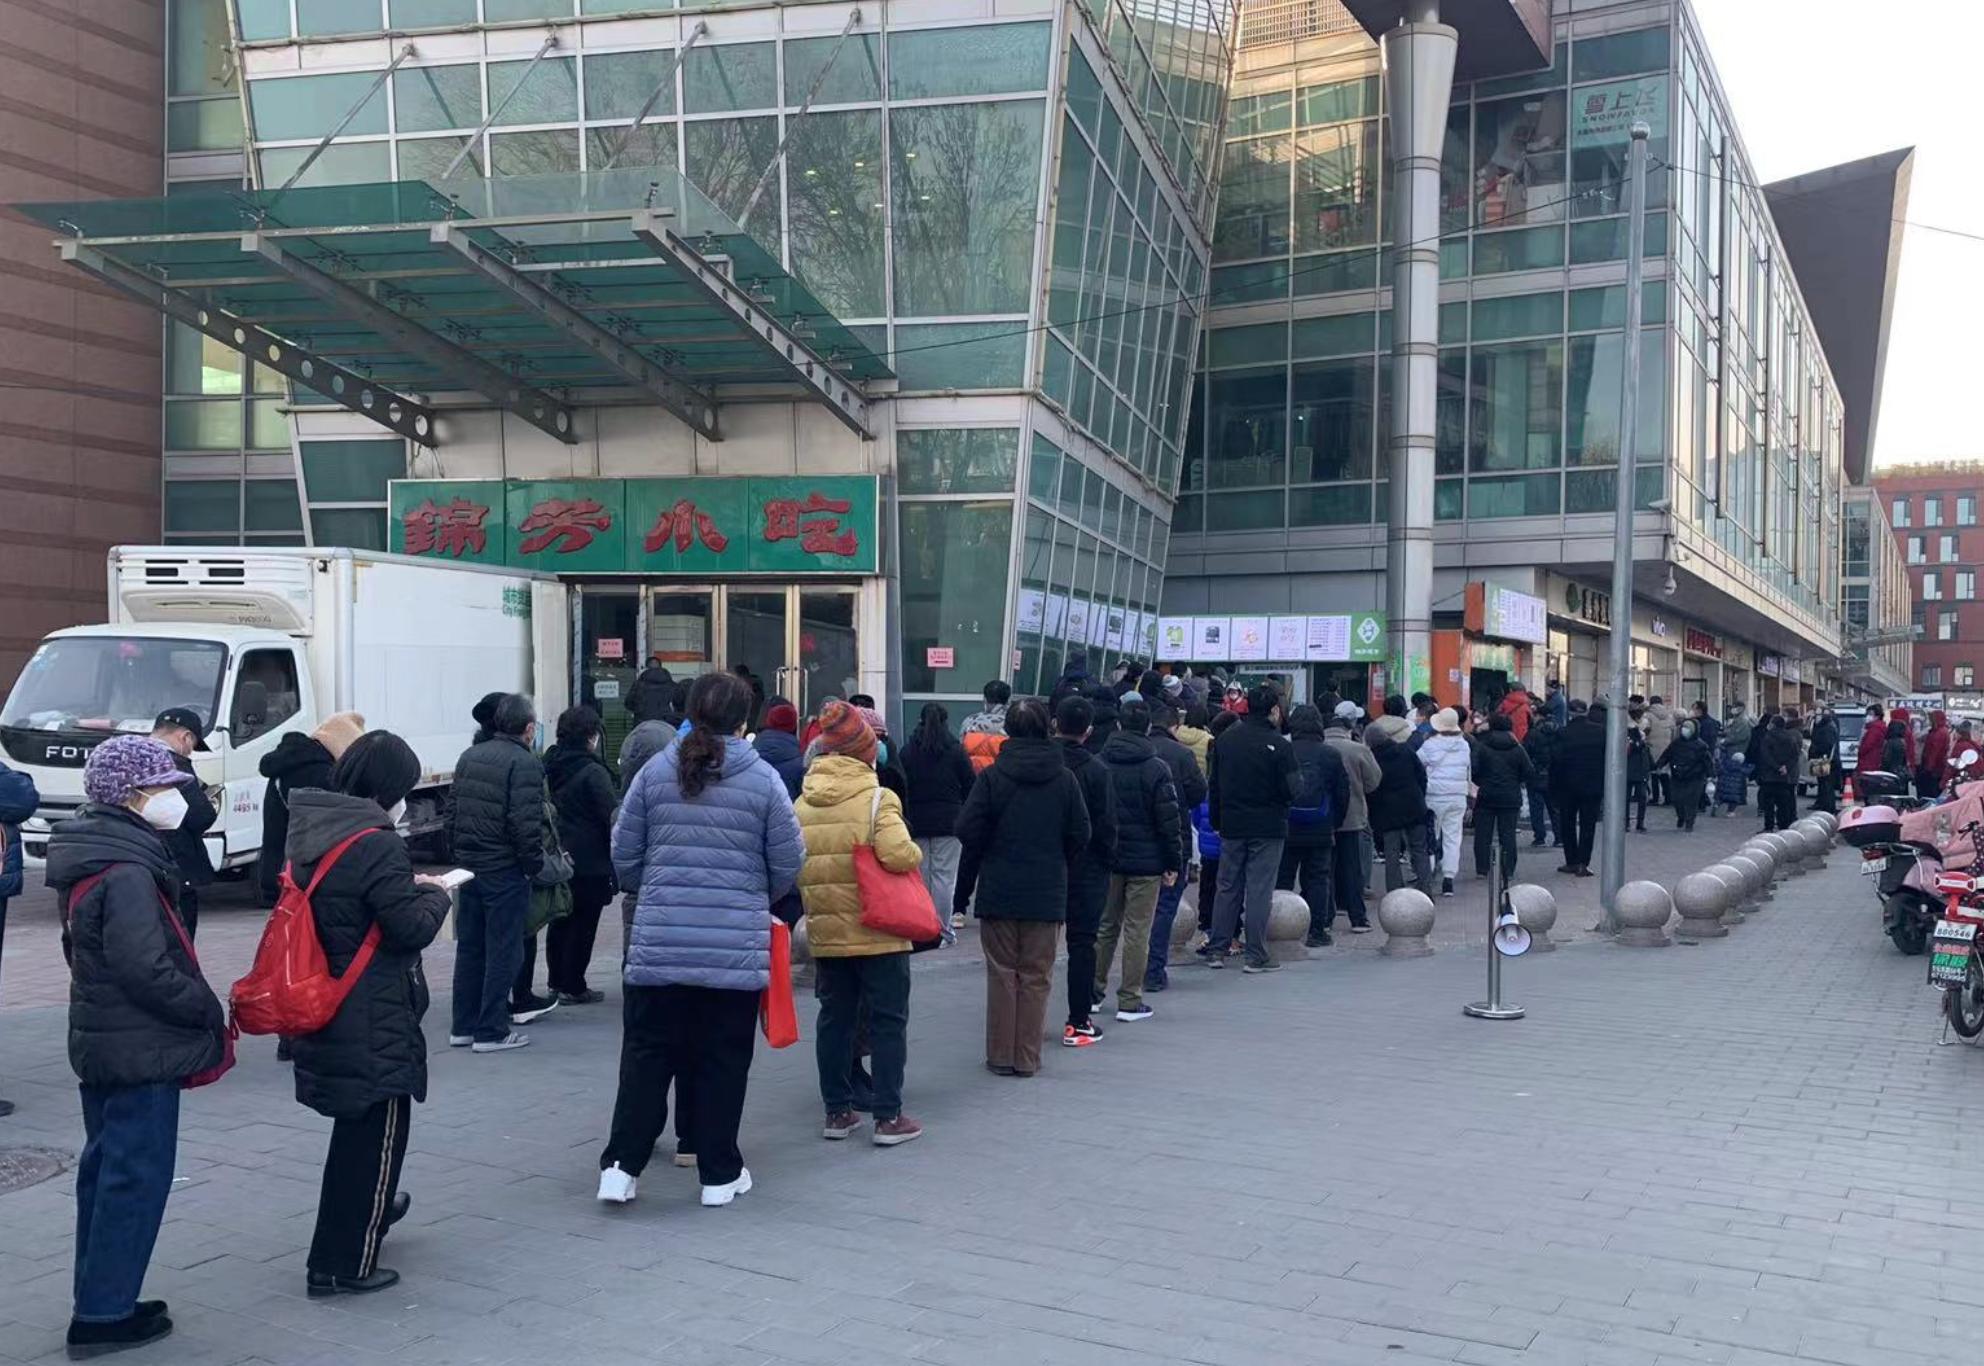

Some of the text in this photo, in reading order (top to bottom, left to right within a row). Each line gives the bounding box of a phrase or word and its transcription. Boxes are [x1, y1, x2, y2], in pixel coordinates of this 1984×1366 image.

[404, 492, 859, 557] 錦芳小吃
[46, 746, 95, 759] FOT
